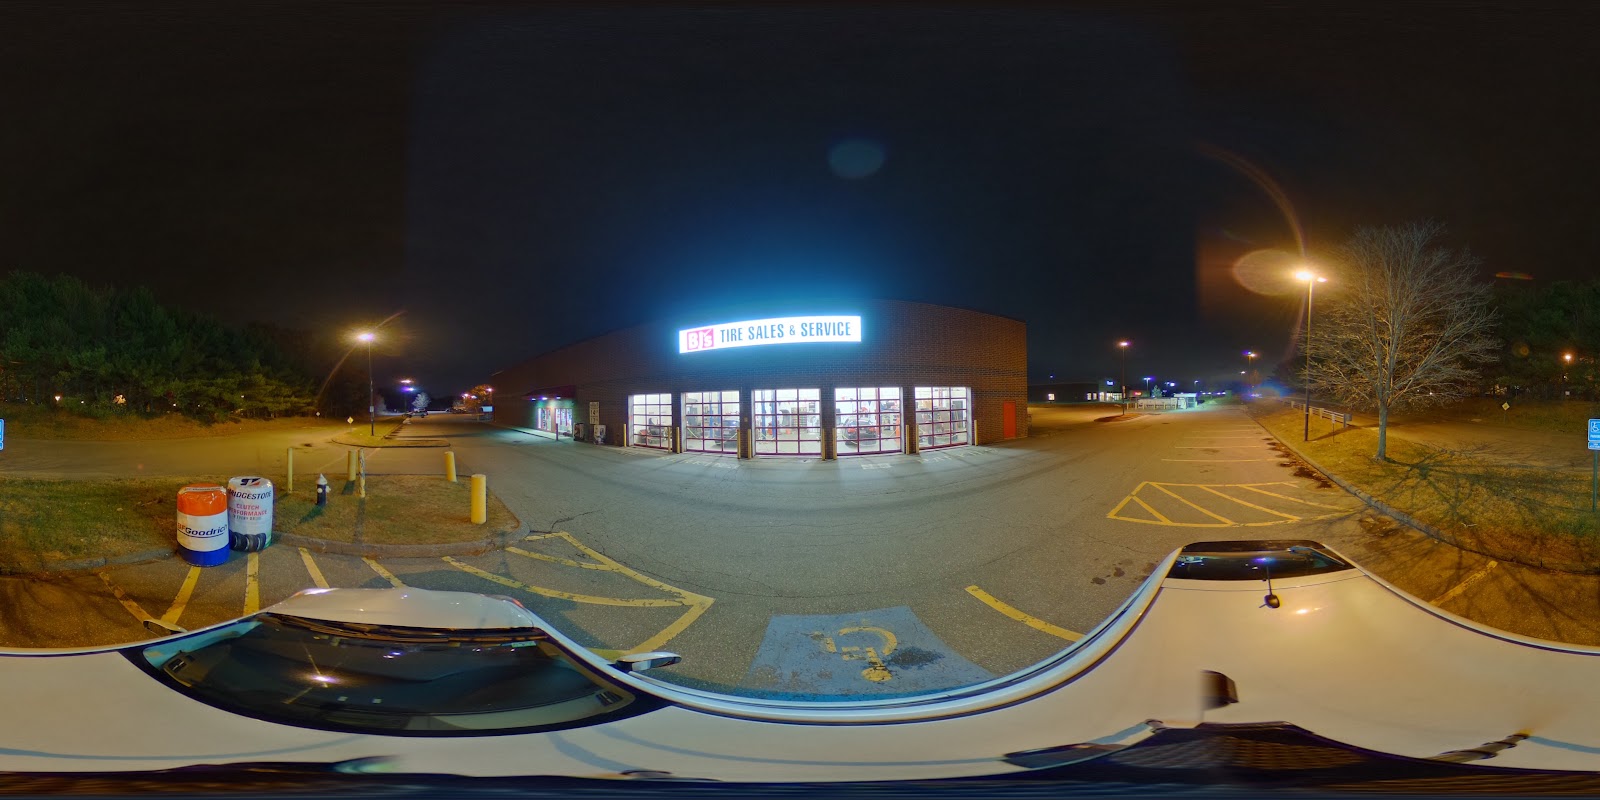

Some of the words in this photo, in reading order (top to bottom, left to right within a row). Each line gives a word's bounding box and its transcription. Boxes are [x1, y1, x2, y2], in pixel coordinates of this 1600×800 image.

[687, 328, 714, 350] BJ's
[720, 327, 743, 343] TIRE
[748, 323, 785, 340] SALES
[789, 324, 796, 336] &
[800, 321, 852, 337] SERVICE
[236, 503, 260, 511] CLUTCH
